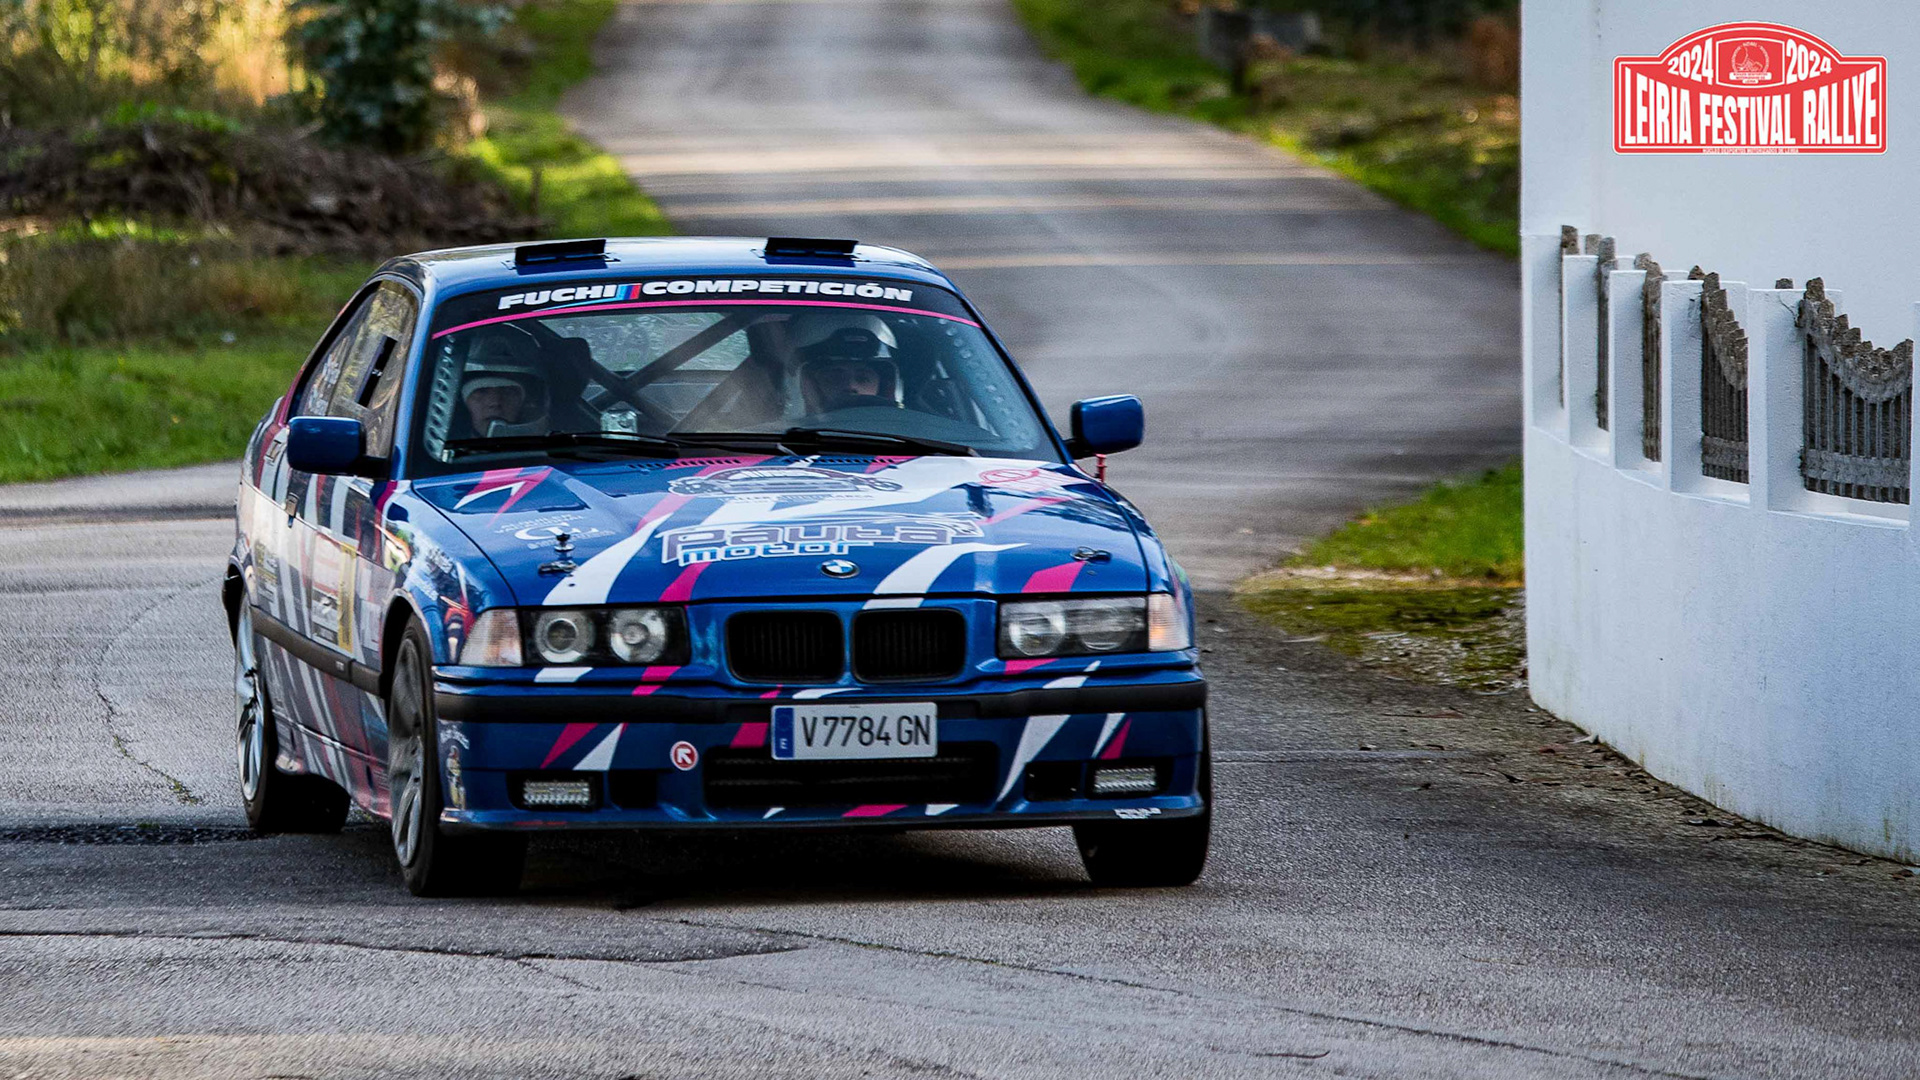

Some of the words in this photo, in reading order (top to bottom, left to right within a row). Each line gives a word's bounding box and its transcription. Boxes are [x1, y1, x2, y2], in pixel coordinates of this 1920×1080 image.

[497, 284, 617, 310] FUCHI
[641, 280, 913, 303] COMPETICIÓN
[661, 523, 953, 564] Pauta
[679, 541, 874, 567] motor
